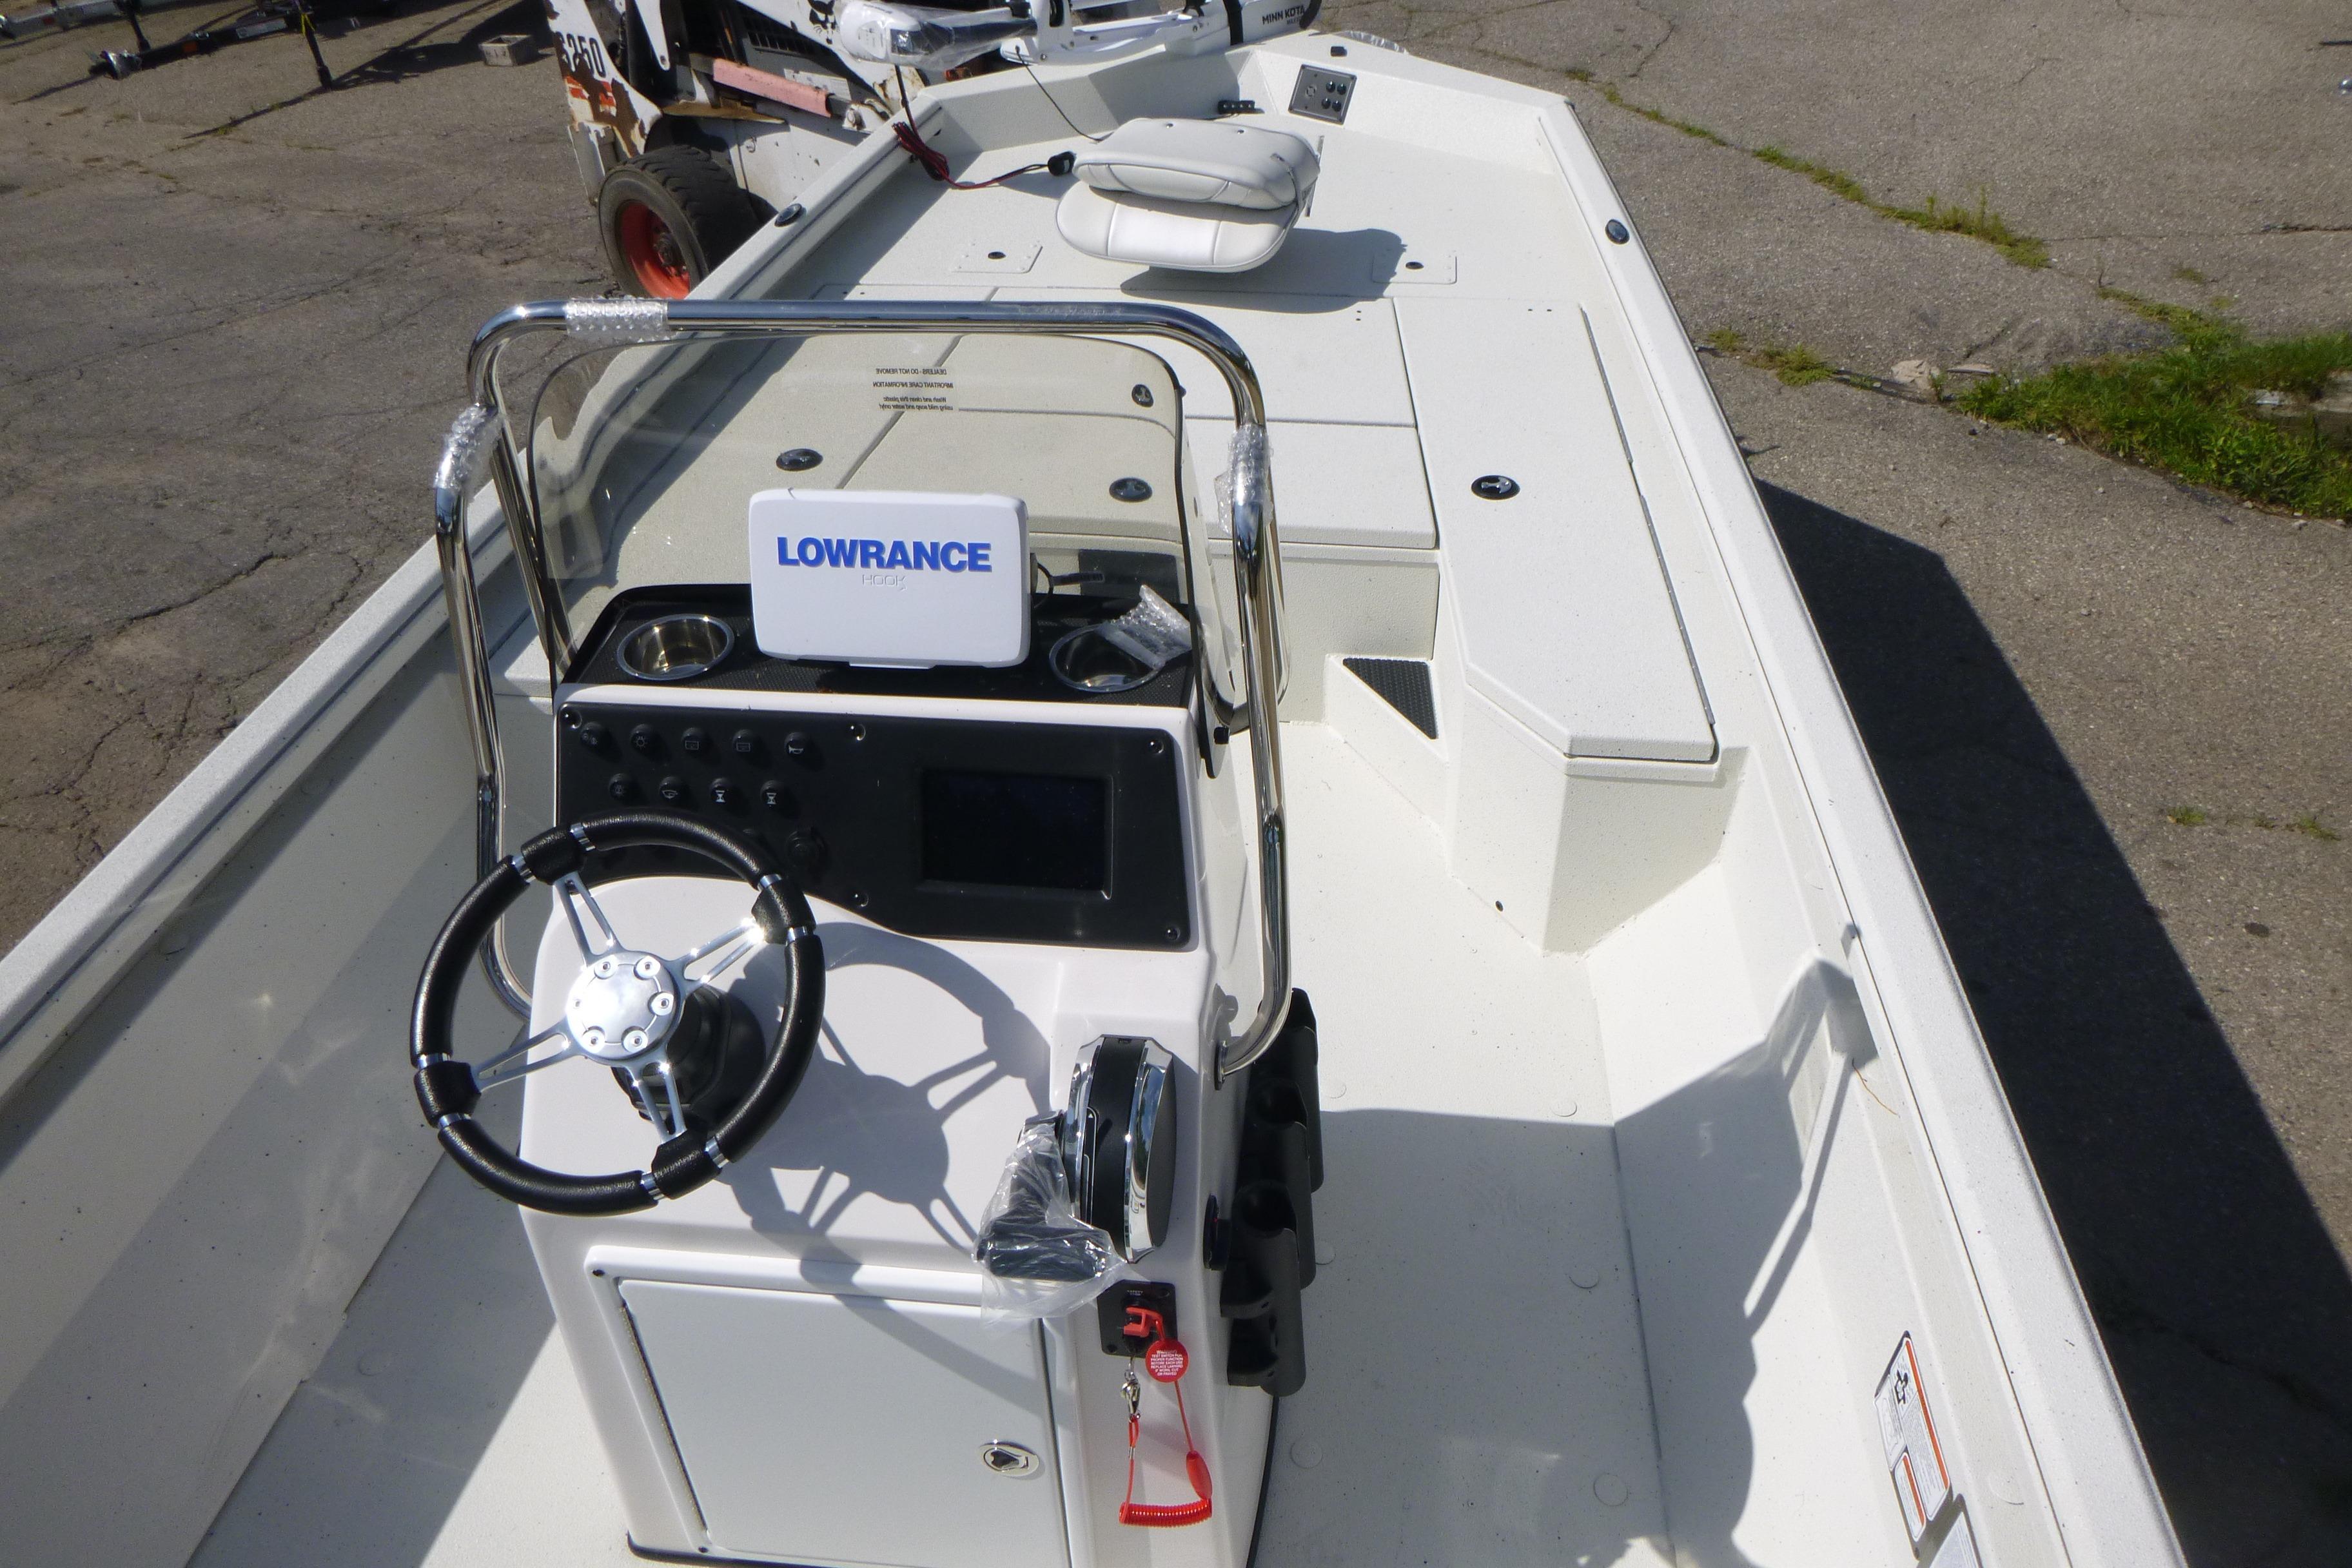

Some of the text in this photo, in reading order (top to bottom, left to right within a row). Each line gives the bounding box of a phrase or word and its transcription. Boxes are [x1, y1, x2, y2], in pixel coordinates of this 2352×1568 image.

[1262, 10, 1284, 25] MINN
[777, 536, 992, 573] LOWRANCE
[862, 574, 908, 592] HOOK
